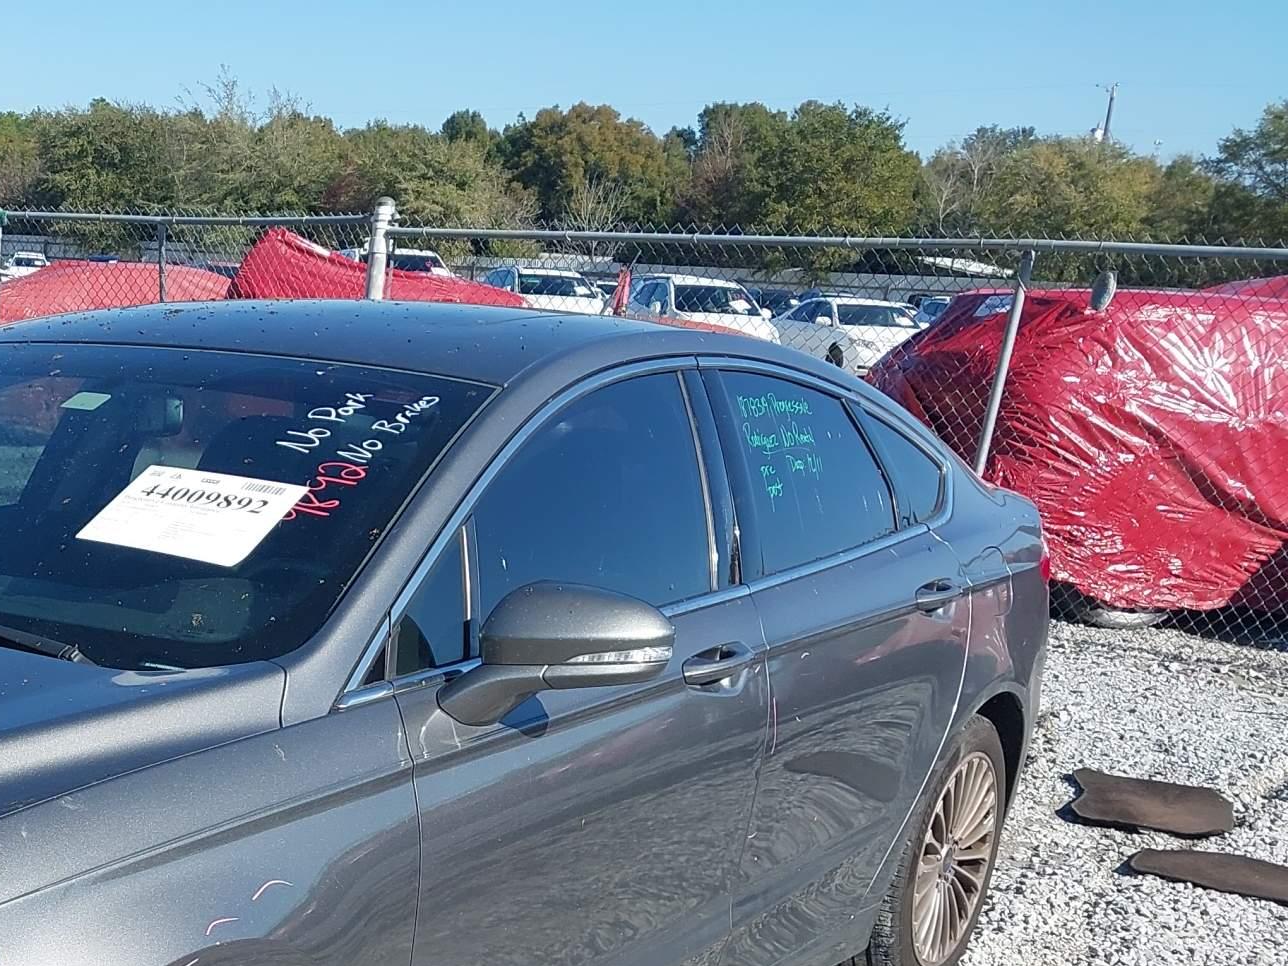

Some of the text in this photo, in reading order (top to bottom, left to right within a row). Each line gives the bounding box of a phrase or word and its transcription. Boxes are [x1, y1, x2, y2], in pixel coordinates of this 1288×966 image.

[276, 392, 374, 453] No Park
[336, 439, 382, 463] No
[371, 395, 440, 434] Brakes
[141, 483, 269, 514] 44009892
